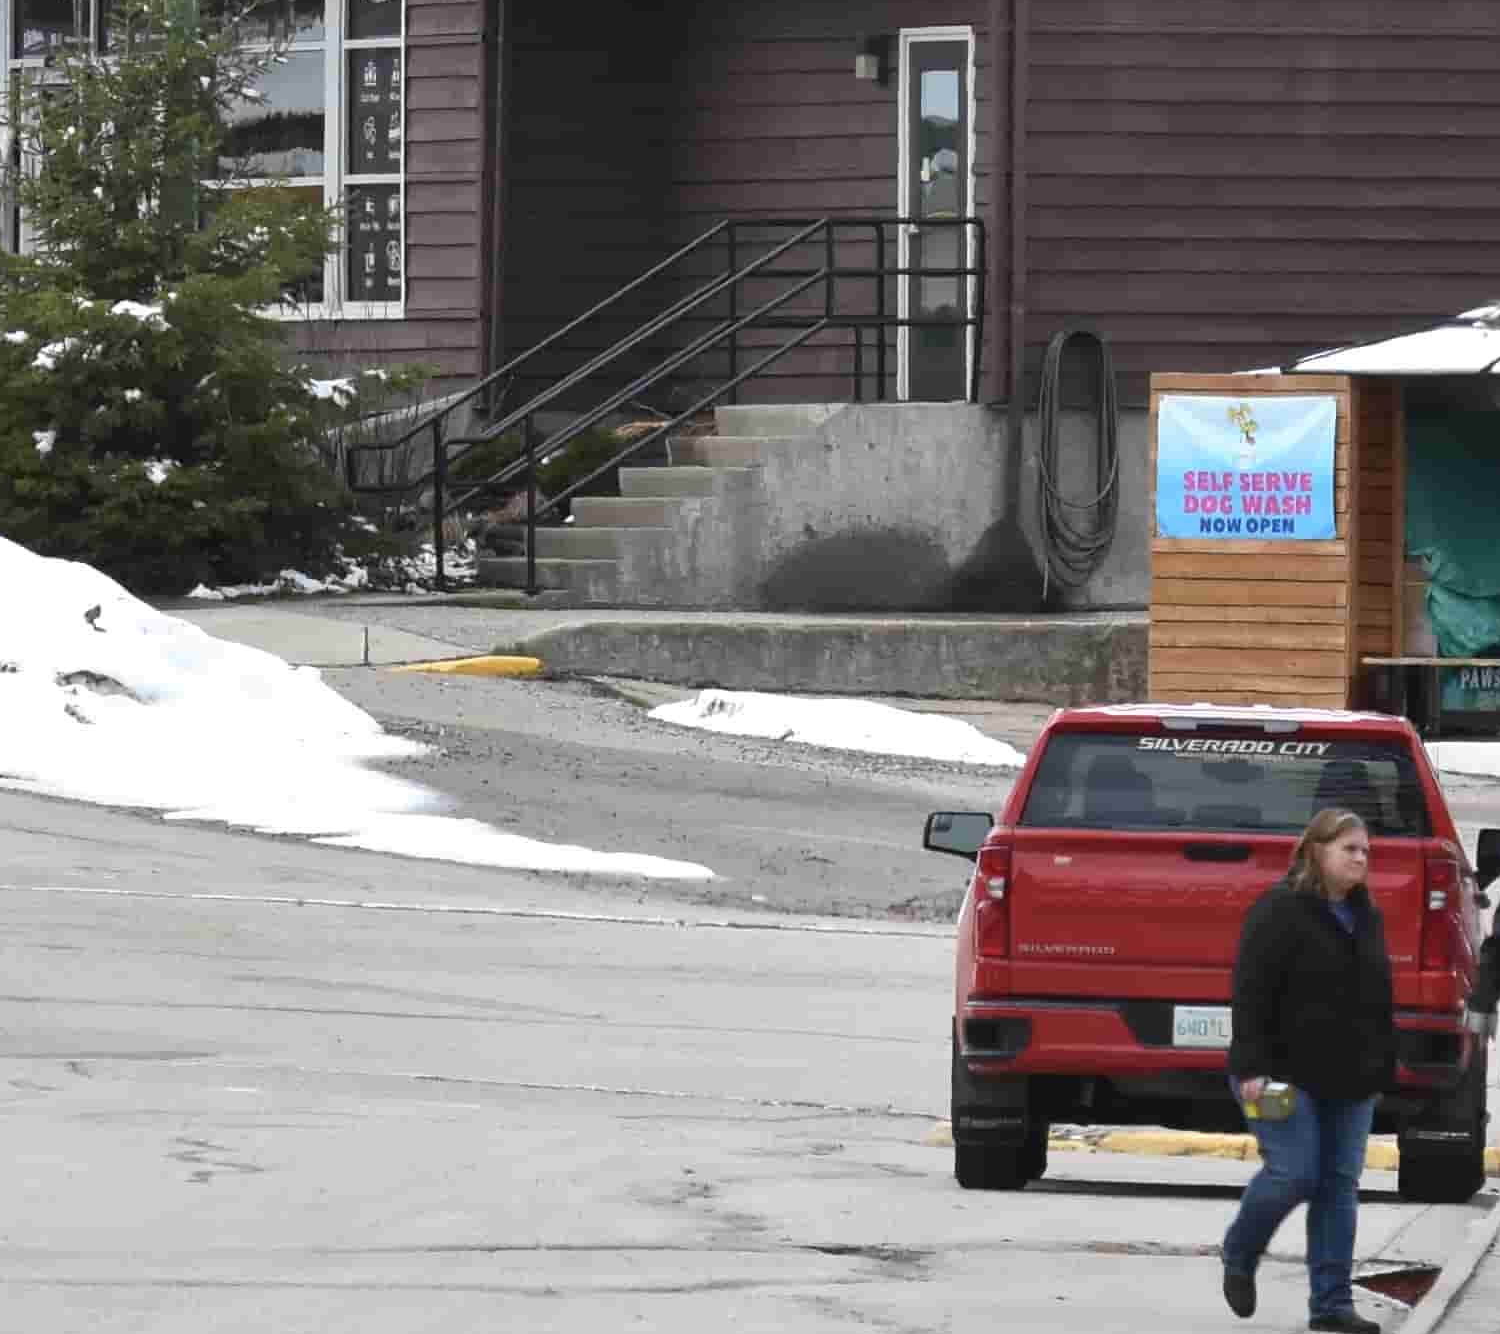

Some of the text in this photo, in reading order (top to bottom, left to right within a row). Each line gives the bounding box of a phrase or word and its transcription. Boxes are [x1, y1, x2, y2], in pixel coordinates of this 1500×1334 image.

[1183, 471, 1313, 492] SELF SERVE
[1183, 494, 1312, 515] DOG WASH
[1200, 517, 1295, 534] NOW OPEN
[1136, 737, 1332, 755] SILVERADO CITY
